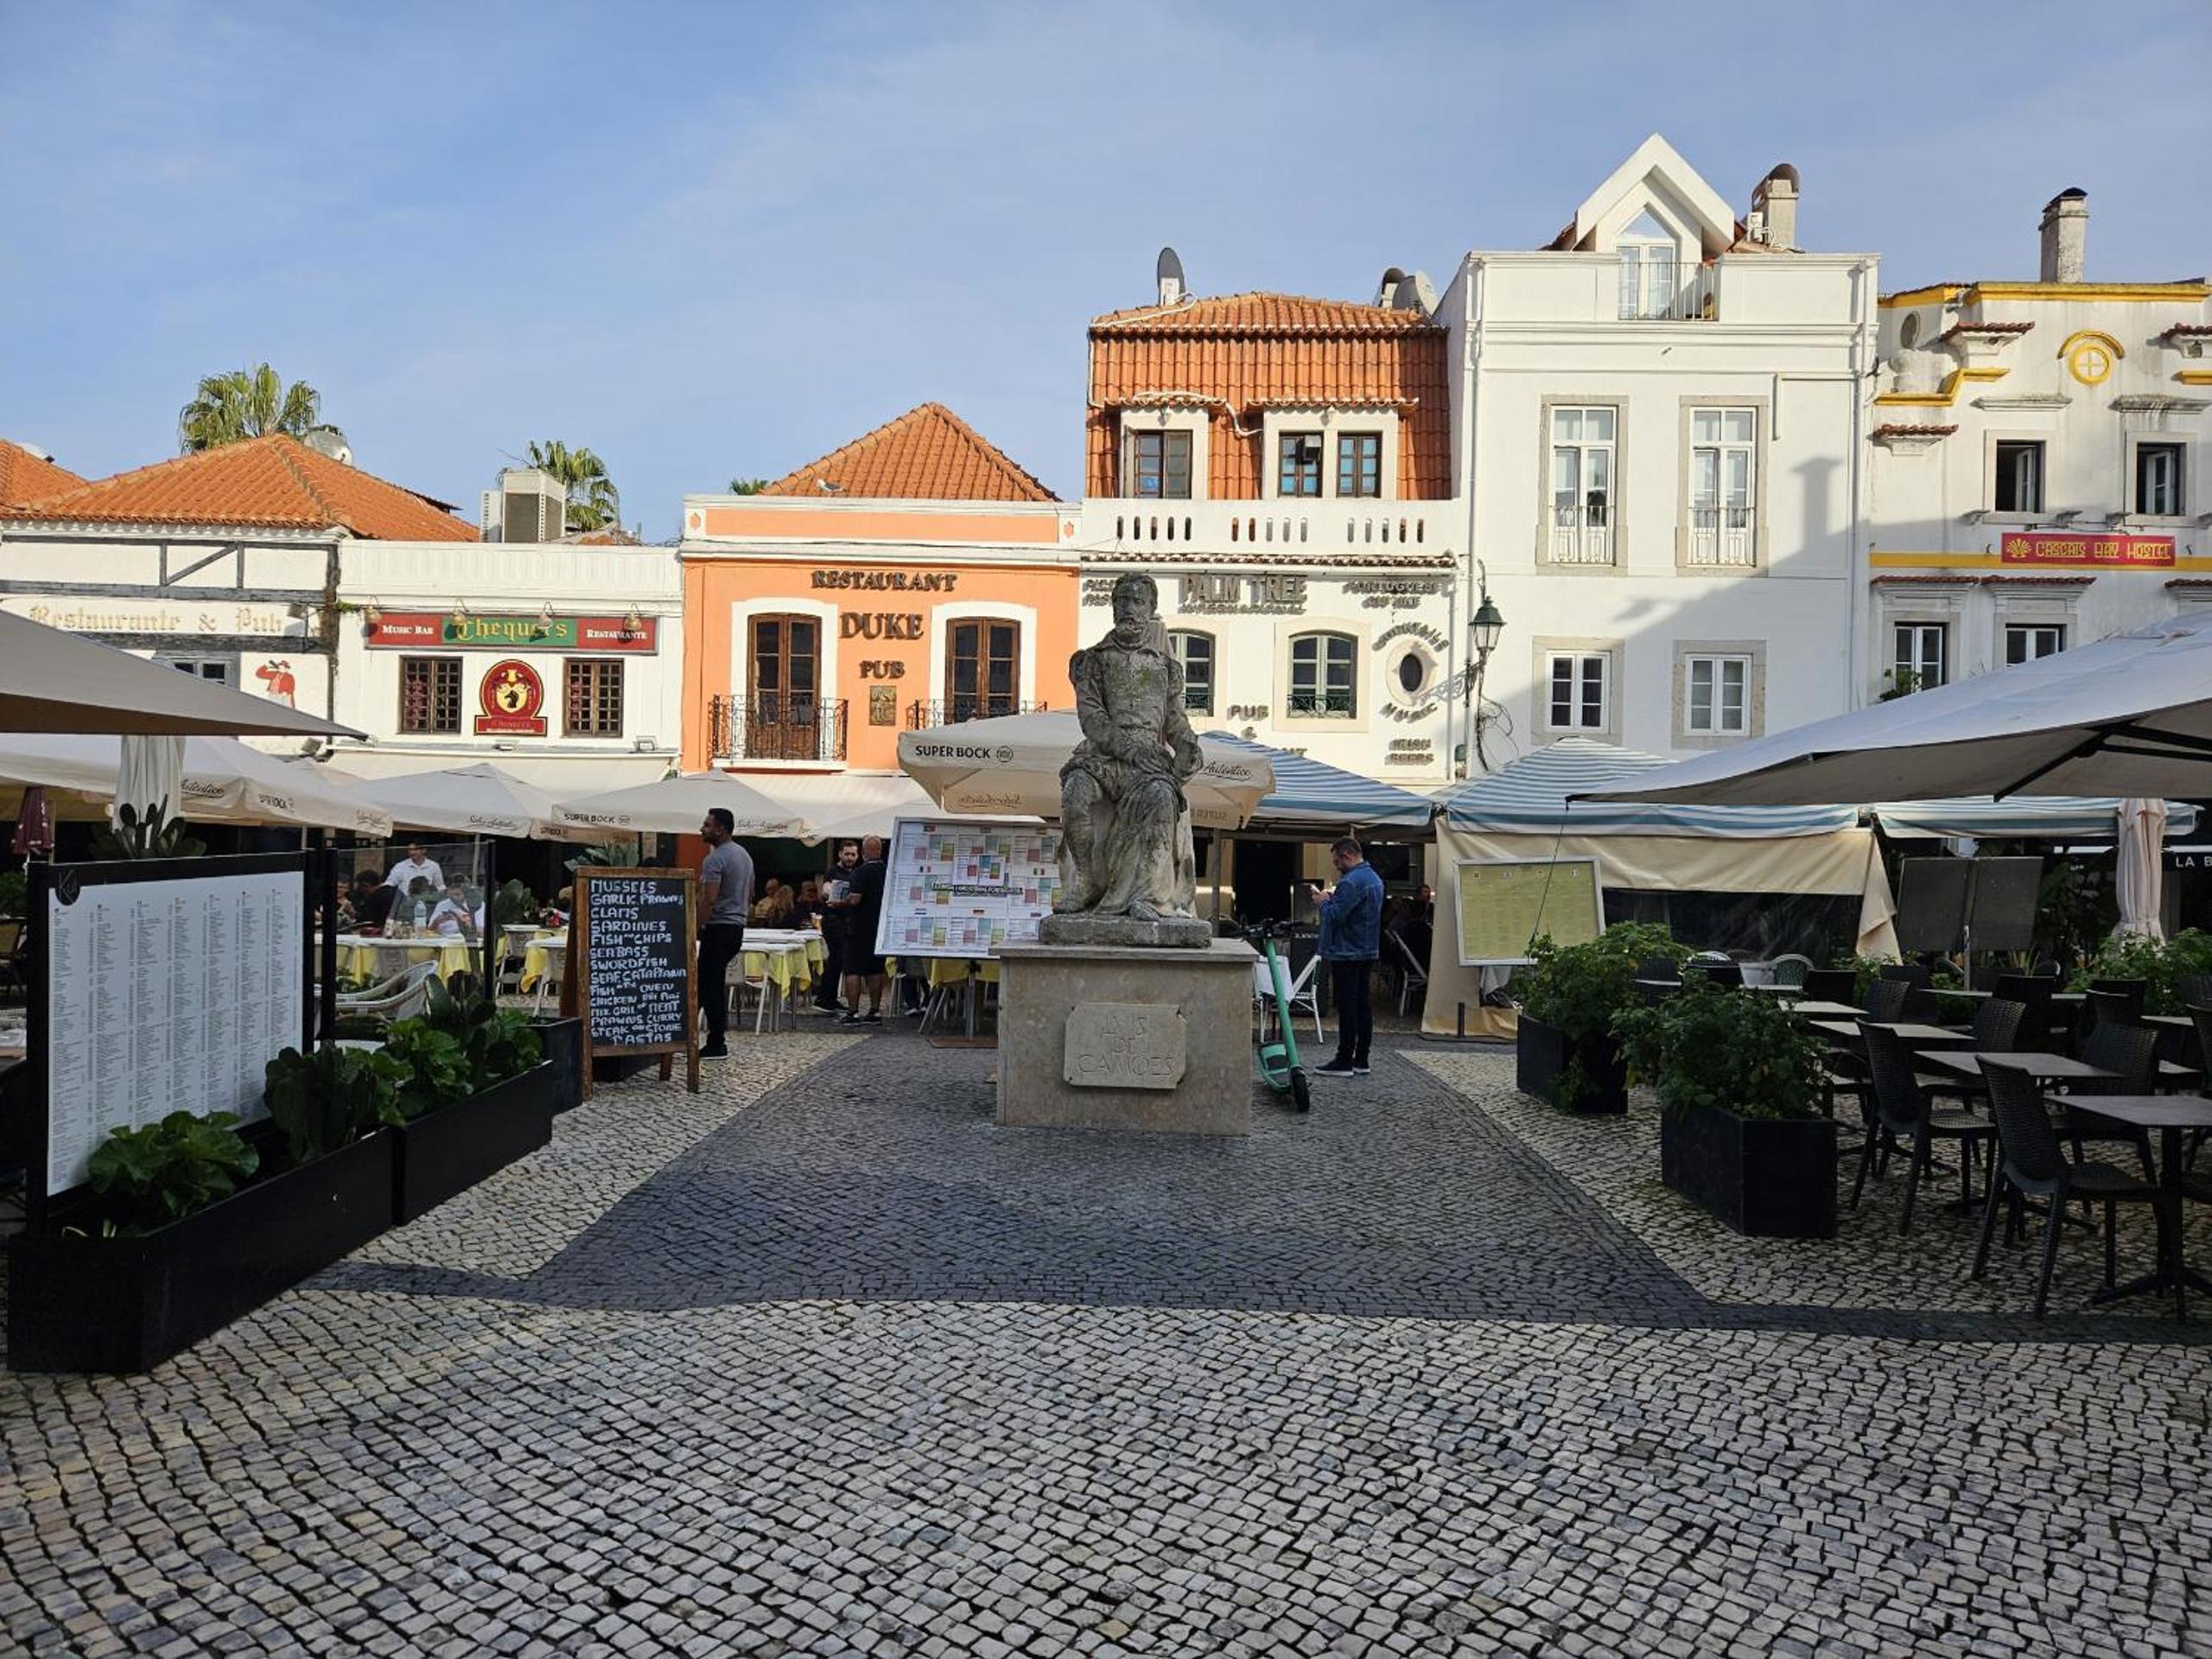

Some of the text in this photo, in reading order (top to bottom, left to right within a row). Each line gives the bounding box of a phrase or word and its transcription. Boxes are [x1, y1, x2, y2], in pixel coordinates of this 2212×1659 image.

[2036, 541, 2171, 560] CASCAIS BAY HOSTEL
[811, 570, 957, 592] RESTAURANT
[1179, 575, 1307, 604] PALM TREE
[29, 604, 283, 632] Restaurante & Pub
[383, 625, 434, 635] MUSIC BAR
[840, 612, 924, 640] DUKE
[860, 660, 905, 679] PUB
[1228, 705, 1268, 721] PUB
[1381, 702, 1438, 723] MUSIC
[916, 746, 953, 757] SUPER
[957, 747, 990, 759] BOCK
[564, 813, 615, 823] SUPER BOCK
[2176, 856, 2196, 868] LA
[591, 880, 657, 893] MUSSELS
[591, 907, 639, 919] CLAMS
[591, 920, 666, 934] SARDINES
[591, 934, 623, 946] FISH
[635, 932, 672, 944] CHIPS
[591, 958, 667, 969] SWORDFISH
[591, 985, 615, 996] FISH
[639, 983, 674, 994] OVEN
[591, 995, 637, 1007] CHICKEN
[591, 1007, 610, 1018] MIX
[649, 1001, 680, 1013] MEAT
[591, 1013, 682, 1027] PRAWNS CURRY
[591, 1026, 629, 1037] STEAK
[645, 1023, 682, 1033] STONE
[612, 1033, 672, 1045] PASTAS
